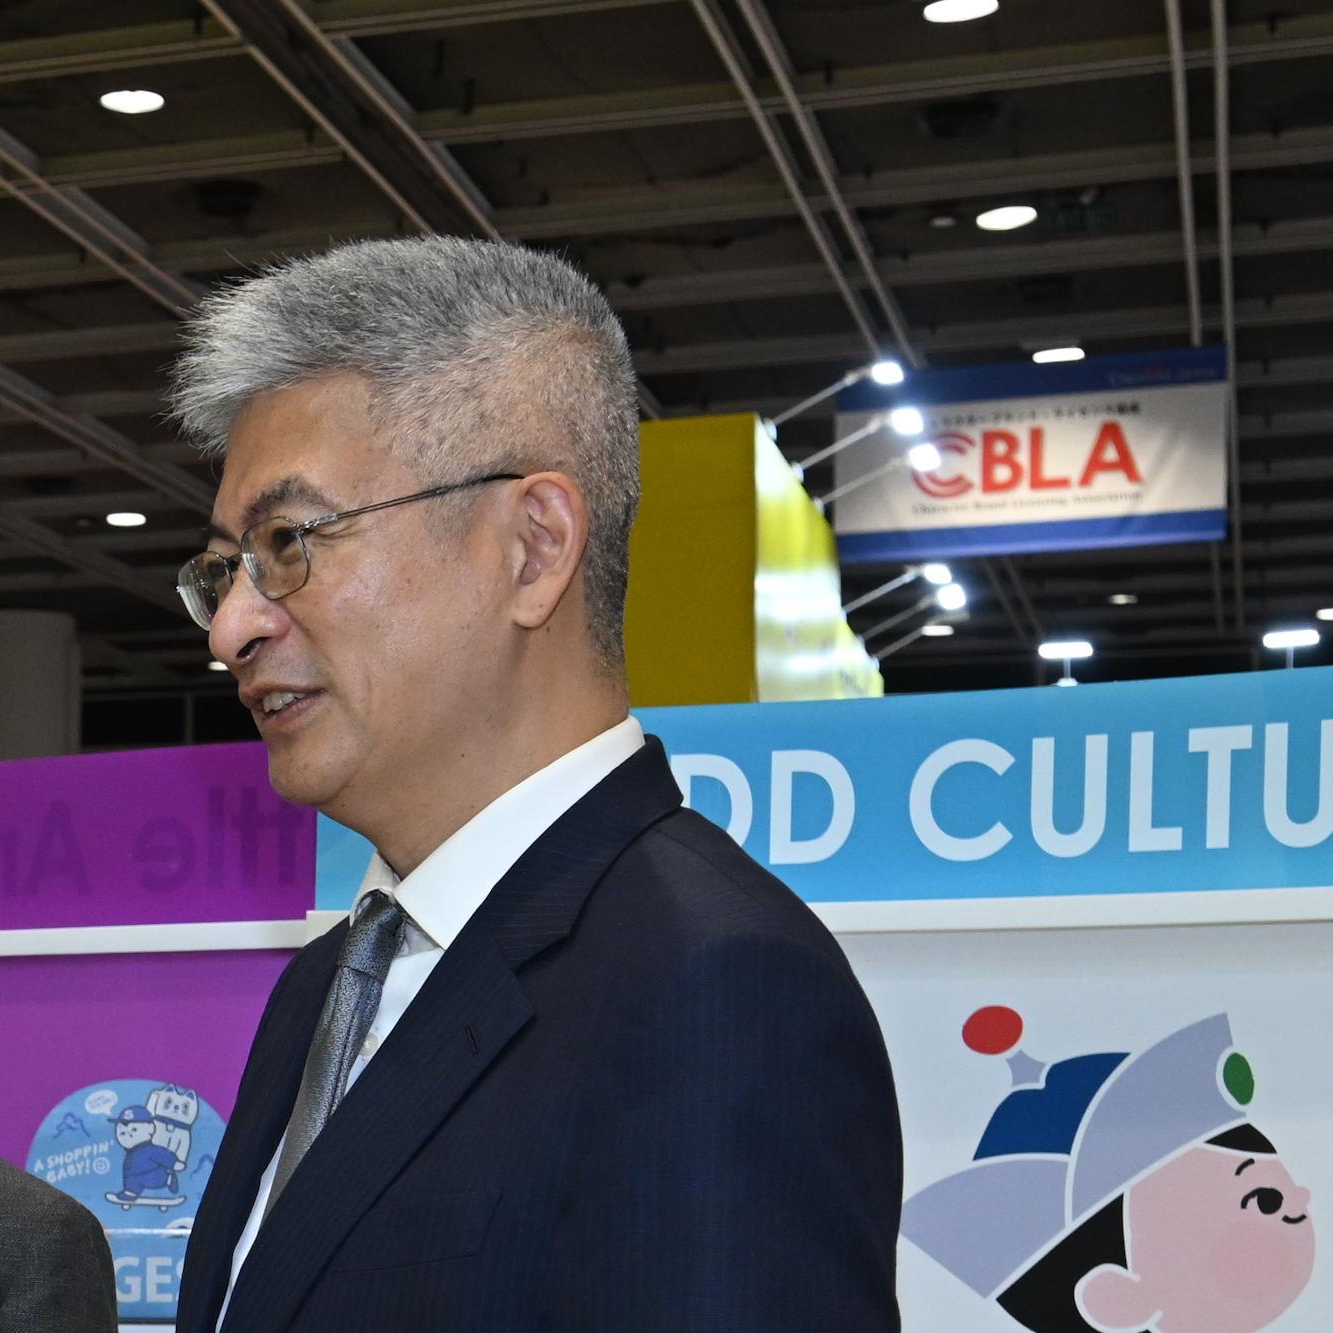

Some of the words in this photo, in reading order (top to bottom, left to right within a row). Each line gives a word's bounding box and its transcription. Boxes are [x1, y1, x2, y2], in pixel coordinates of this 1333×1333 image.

[911, 420, 1143, 498] CBLA
[909, 719, 1333, 862] CULTU
[115, 1256, 182, 1304] GE
